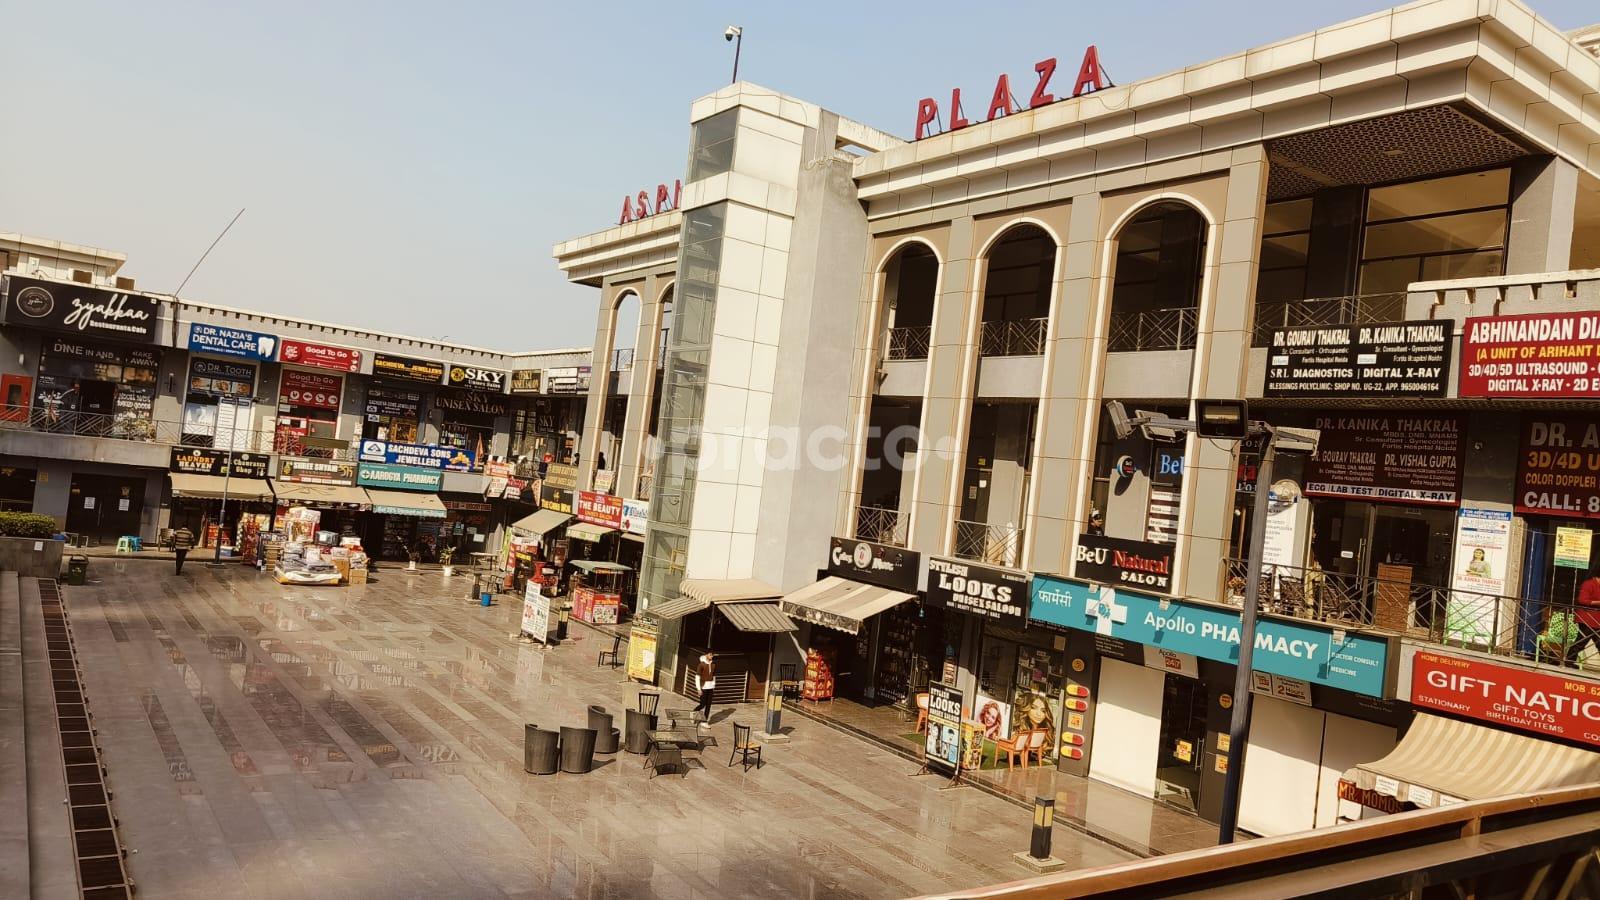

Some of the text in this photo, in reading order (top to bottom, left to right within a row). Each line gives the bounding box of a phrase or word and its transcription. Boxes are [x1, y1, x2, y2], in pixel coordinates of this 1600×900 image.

[915, 45, 1102, 141] PLAZA
[203, 328, 252, 341] DR. NAZIA'S
[1274, 330, 1351, 346] DR. GOURAV THAKRAL
[1359, 325, 1445, 344] DR. KANIKA THAKRAL
[1470, 316, 1600, 344] ABHINANDAN DI
[54, 343, 84, 355] DINE
[192, 334, 229, 347] DENTAL
[231, 339, 257, 351] CARE
[305, 346, 326, 355] Good
[1316, 356, 1334, 364] Hospital
[1491, 347, 1518, 359] UNIT
[1521, 347, 1537, 358] OF
[1539, 345, 1594, 358] ARIHANT
[225, 365, 252, 376] TOOTH
[465, 369, 504, 384] SKY
[1270, 367, 1442, 379] SRL DIAGNOSTICS DIGITAL X-RAY
[1469, 362, 1588, 377] 3D/4D/5D ULTRASOUND
[289, 373, 312, 382] Good
[313, 376, 323, 384] To
[1488, 378, 1588, 391] DIGITAL X-RAY 2D
[1269, 382, 1299, 391] BLESSINGS
[1334, 383, 1351, 391] SHOP
[1352, 383, 1362, 391] NO.
[1364, 383, 1384, 393] UG-22,
[1385, 383, 1400, 391] APP.
[436, 397, 505, 415] UNISEX SALON
[1316, 417, 1459, 434] DR. KANIKA THAKRAL
[1530, 422, 1573, 447] DR.
[388, 443, 452, 460] SACHDEVA SONS
[1382, 442, 1402, 450] Fortis
[1404, 443, 1432, 451] Hospital
[177, 455, 216, 464] LAUNDRY
[180, 461, 212, 470] HEAVEN
[396, 454, 441, 469] JEWELLERS
[1322, 451, 1377, 465] GOURAV THAKRAL
[1384, 453, 1457, 469] DR. VISHAL GUPTA
[1528, 451, 1582, 470] 3D/4D
[370, 471, 440, 486] AAROGYA PHARMACY
[1525, 473, 1597, 488] COLOR DOPPLER
[1309, 484, 1453, 500] ECG LAB TEST DIGITAL X-RAY
[579, 500, 592, 512] THE
[593, 502, 621, 517] BEAUTY
[1524, 491, 1581, 511] CALL:
[1077, 545, 1109, 565] BeU
[1112, 550, 1169, 574] Natural
[929, 559, 968, 577] STYLISH
[1121, 571, 1168, 588] SALON
[938, 573, 1012, 603] LOOKS
[953, 592, 1022, 617] UNISEX SALOON
[1038, 588, 1073, 608] फार्मेसी
[1143, 616, 1318, 667] Apollo PHAMACY
[1354, 656, 1379, 667] CONSULT
[1420, 654, 1470, 669] HOME DELIVERY
[1331, 666, 1356, 677] MEDICINE
[1277, 686, 1286, 696] 2
[1427, 670, 1497, 698] GIFT
[1564, 682, 1585, 697] MOB
[930, 695, 961, 716] LOOKS
[1419, 695, 1471, 712] STATIONARY
[1493, 702, 1555, 723] GIFT TOYS
[1486, 710, 1565, 735] BIRTHDAY ITEMS
[1583, 732, 1600, 744] CO
